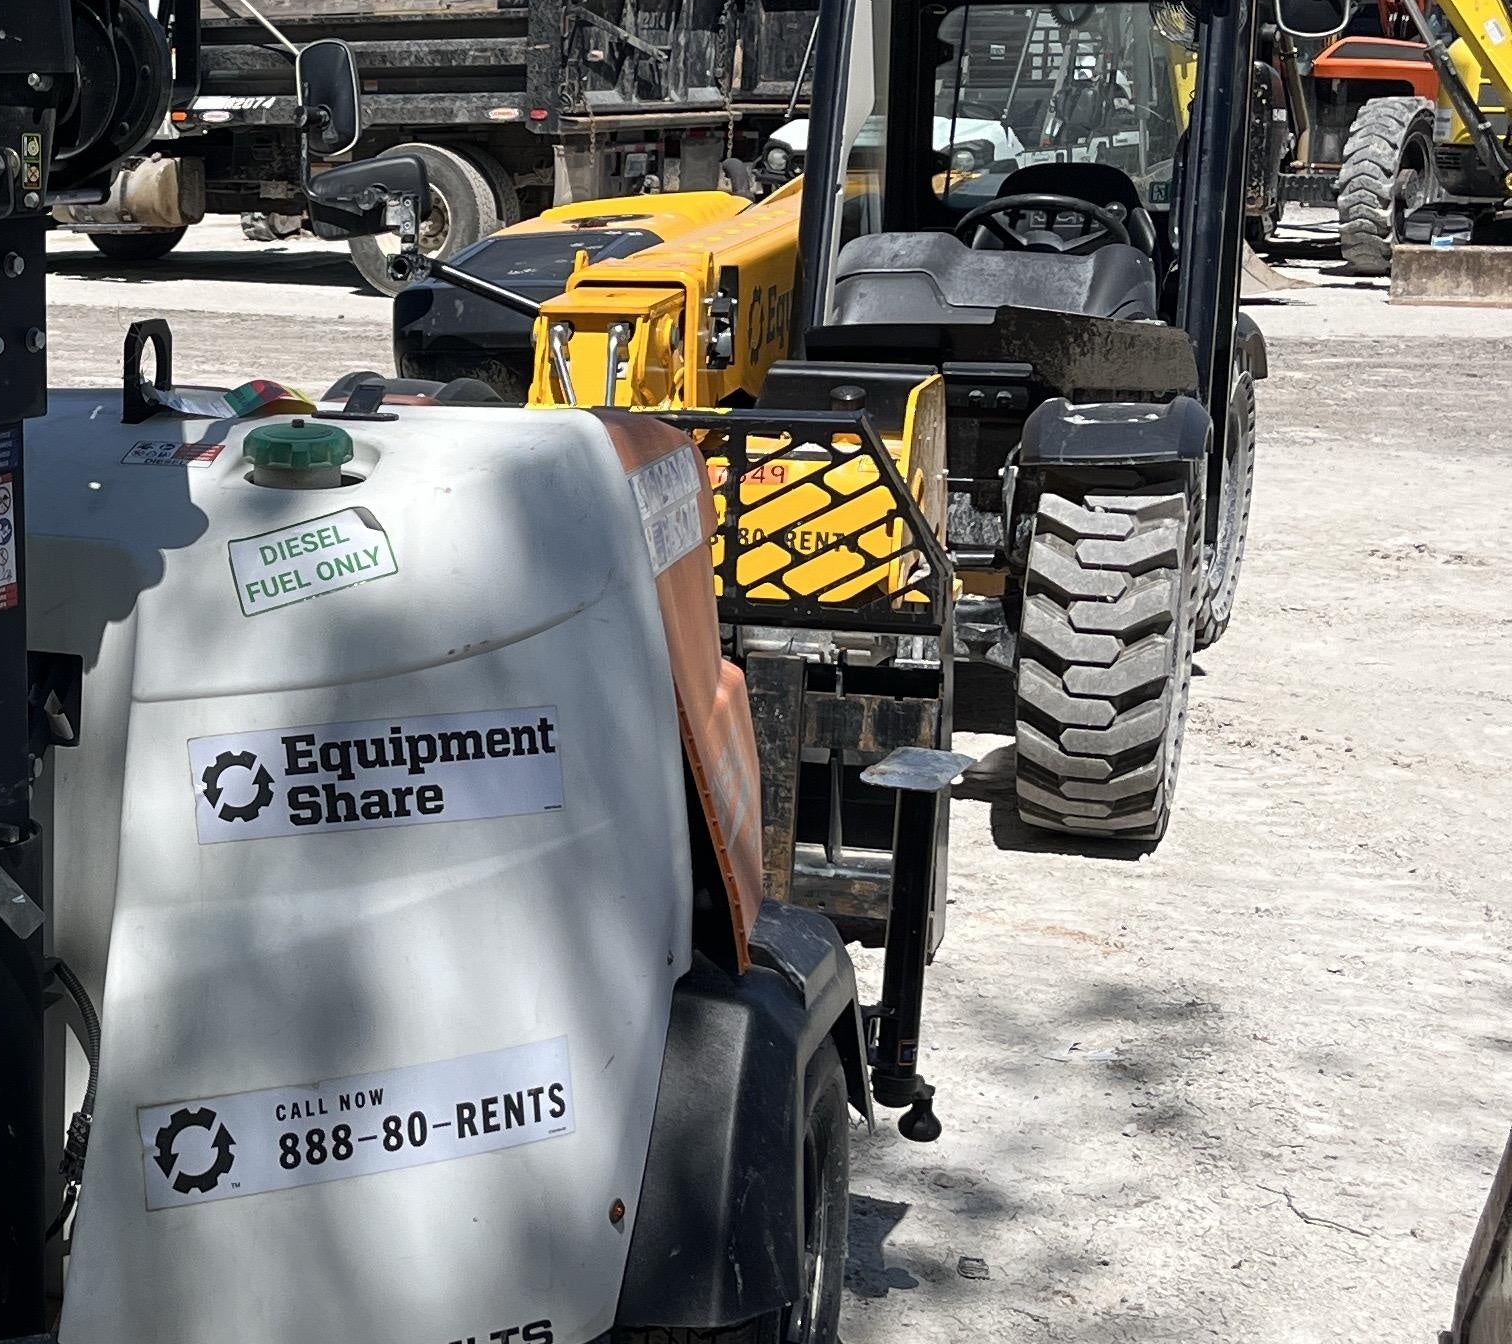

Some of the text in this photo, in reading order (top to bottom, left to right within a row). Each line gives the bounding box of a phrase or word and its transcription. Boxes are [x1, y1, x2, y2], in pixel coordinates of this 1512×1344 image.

[259, 525, 350, 567] DIESEL
[245, 545, 380, 603] FUEL ONLY
[280, 717, 557, 781] Equipment
[287, 782, 445, 827] Share
[276, 1087, 385, 1122] CALL NOW
[278, 1081, 567, 1171] 888-80-RENTS
